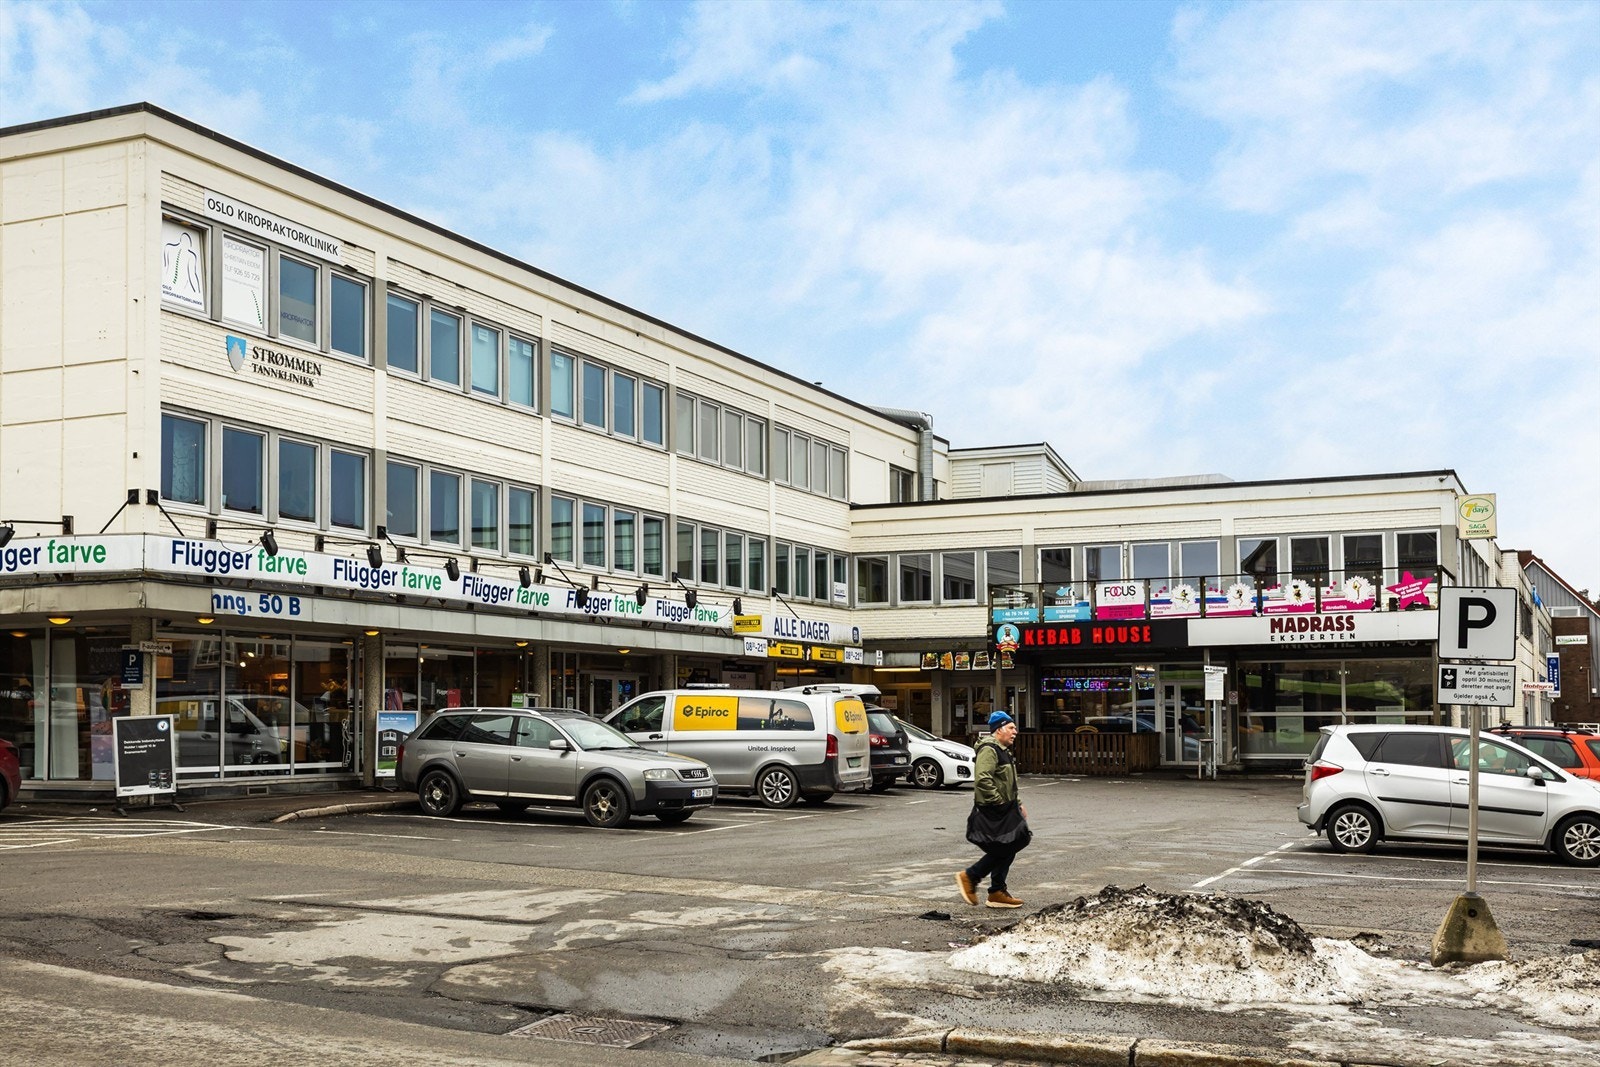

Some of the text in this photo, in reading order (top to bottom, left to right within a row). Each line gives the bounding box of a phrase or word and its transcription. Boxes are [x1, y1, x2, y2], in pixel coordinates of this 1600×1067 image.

[208, 198, 339, 256] OSLO KIROPRAKTORKLINIKK
[252, 346, 322, 376] STRØMMEN
[252, 362, 314, 387] TANNKLINIKK
[1465, 503, 1478, 518] 7
[0, 540, 106, 572] ger farve
[172, 540, 308, 576] Flügger farve
[334, 558, 442, 591] Flügger farve
[462, 575, 550, 606] Flügger farve
[1104, 585, 1136, 598] FOCUS
[259, 594, 283, 614] 50
[289, 597, 300, 616] B
[566, 590, 642, 614] Flgger farve
[656, 600, 718, 622] Flügger farve
[774, 617, 798, 638] ALLE
[800, 620, 830, 640] DAGER
[1270, 615, 1356, 634] MADRASS
[1458, 597, 1497, 649] P
[1024, 626, 1152, 646] KEBAB HOUSE
[1270, 633, 1356, 642] EKSPERTEN
[130, 654, 136, 666] P
[1065, 680, 1109, 690] Alle dager
[695, 706, 729, 718] Epiroc
